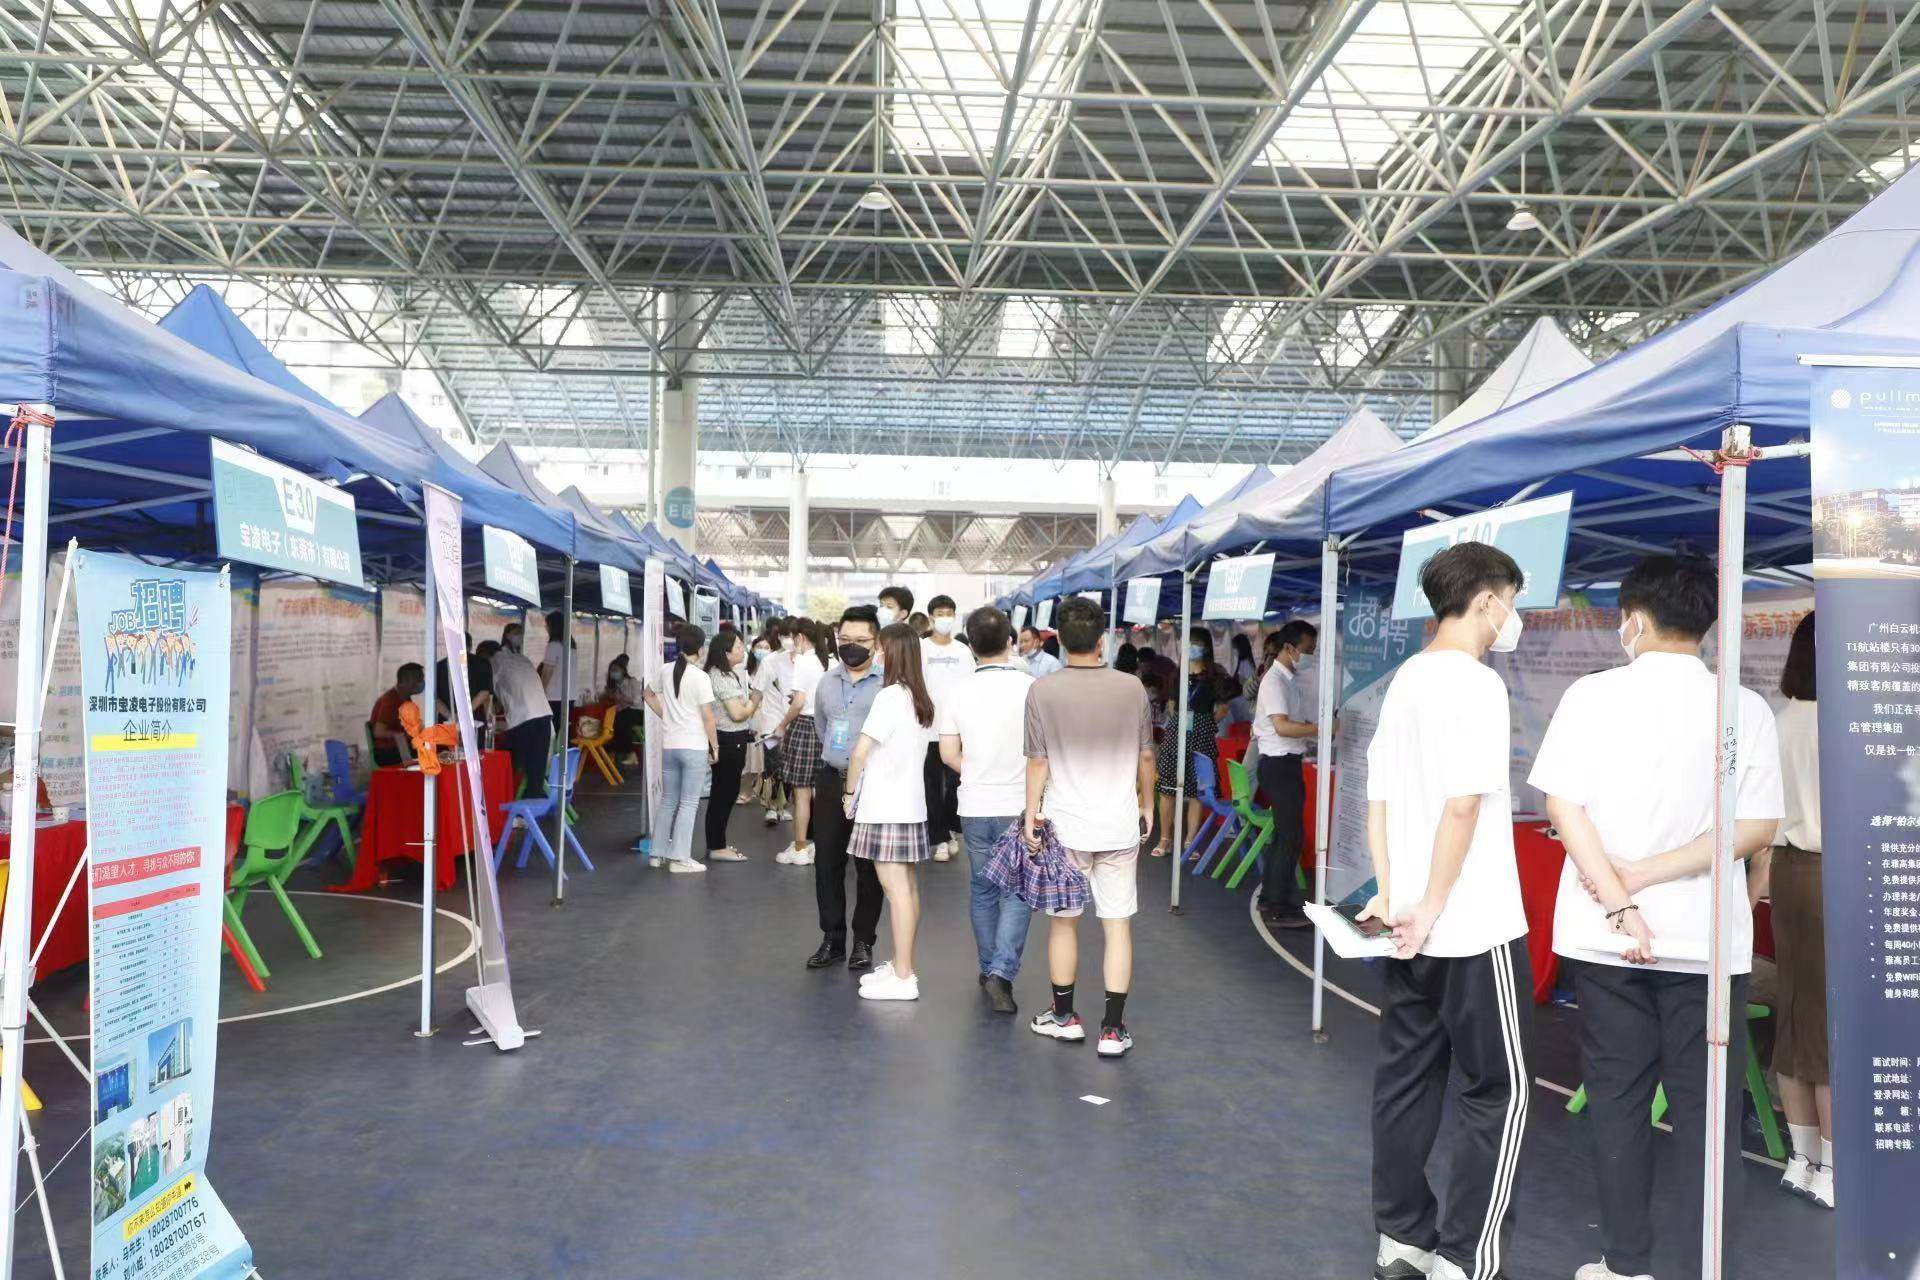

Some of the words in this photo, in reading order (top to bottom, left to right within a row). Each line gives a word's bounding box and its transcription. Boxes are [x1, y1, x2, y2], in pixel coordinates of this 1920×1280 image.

[283, 477, 314, 523] E30
[109, 611, 136, 632] JOB
[131, 580, 186, 633] 招聘
[1868, 622, 1920, 634] 广州白云机
[89, 696, 206, 712] 深圳市宝凌电子股份有限公司
[123, 719, 172, 742] 企业简介
[1849, 721, 1903, 734] 店管理集团
[1884, 923, 1920, 933] 免费提供
[1885, 940, 1920, 950] 每周40小
[1885, 955, 1920, 965] 雅高员工
